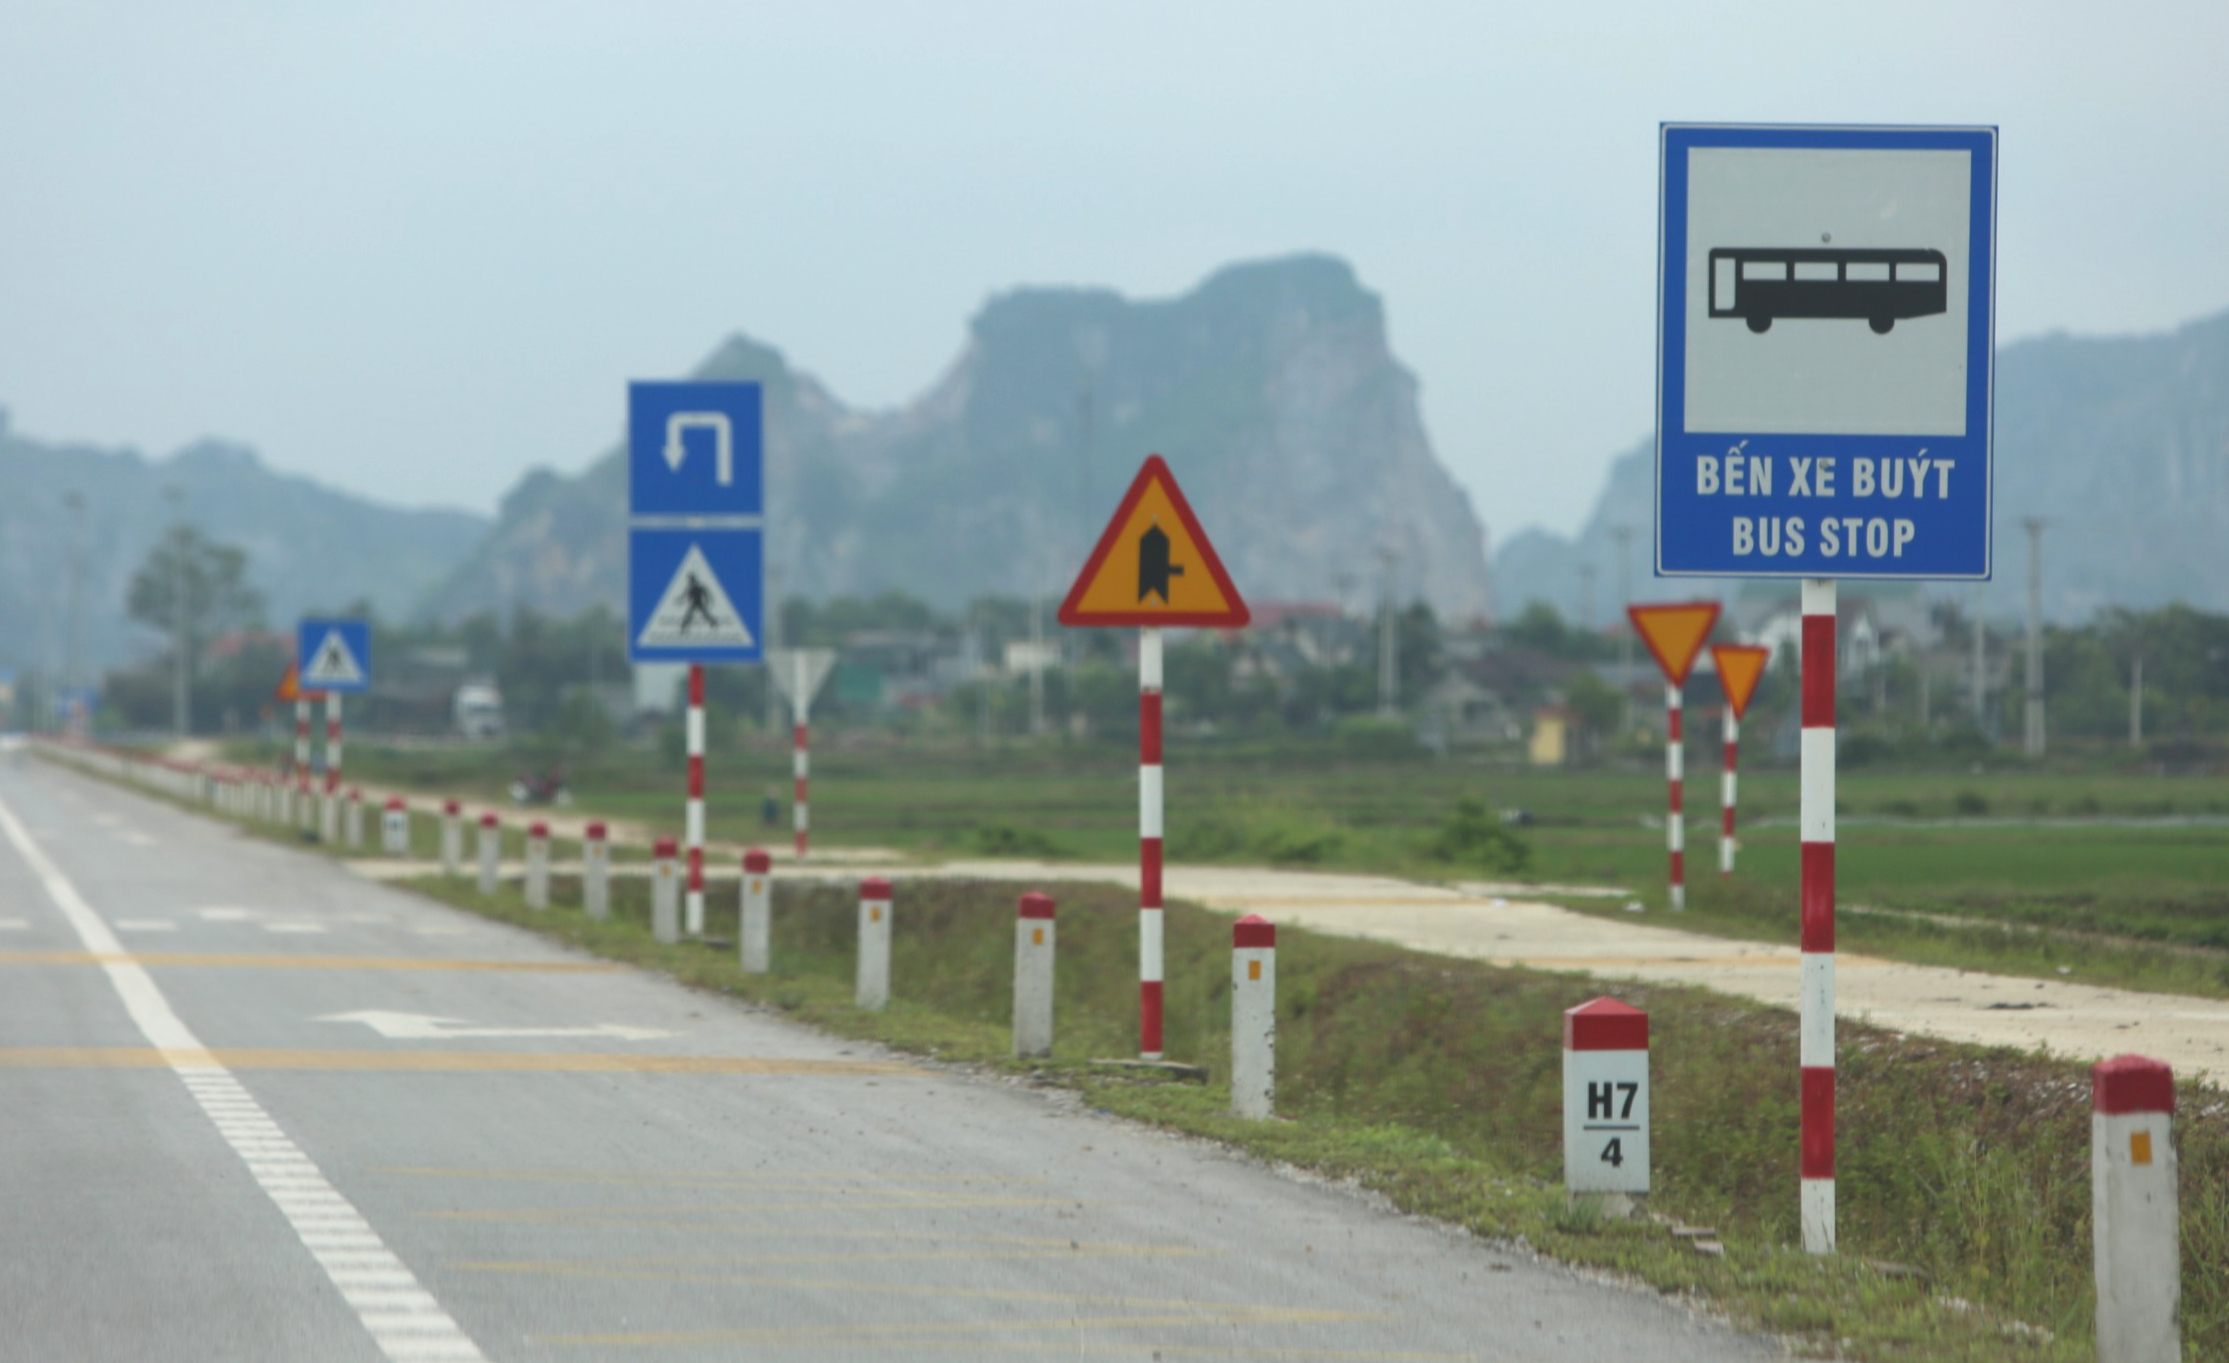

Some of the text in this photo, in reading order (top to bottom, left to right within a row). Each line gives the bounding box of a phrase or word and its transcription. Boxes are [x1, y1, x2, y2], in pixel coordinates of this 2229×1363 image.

[1697, 440, 1955, 499] BẾN XE BUÝT
[1733, 517, 1915, 557] BUS STOP
[1588, 1082, 1639, 1120] H7
[1601, 1138, 1623, 1167] 4
